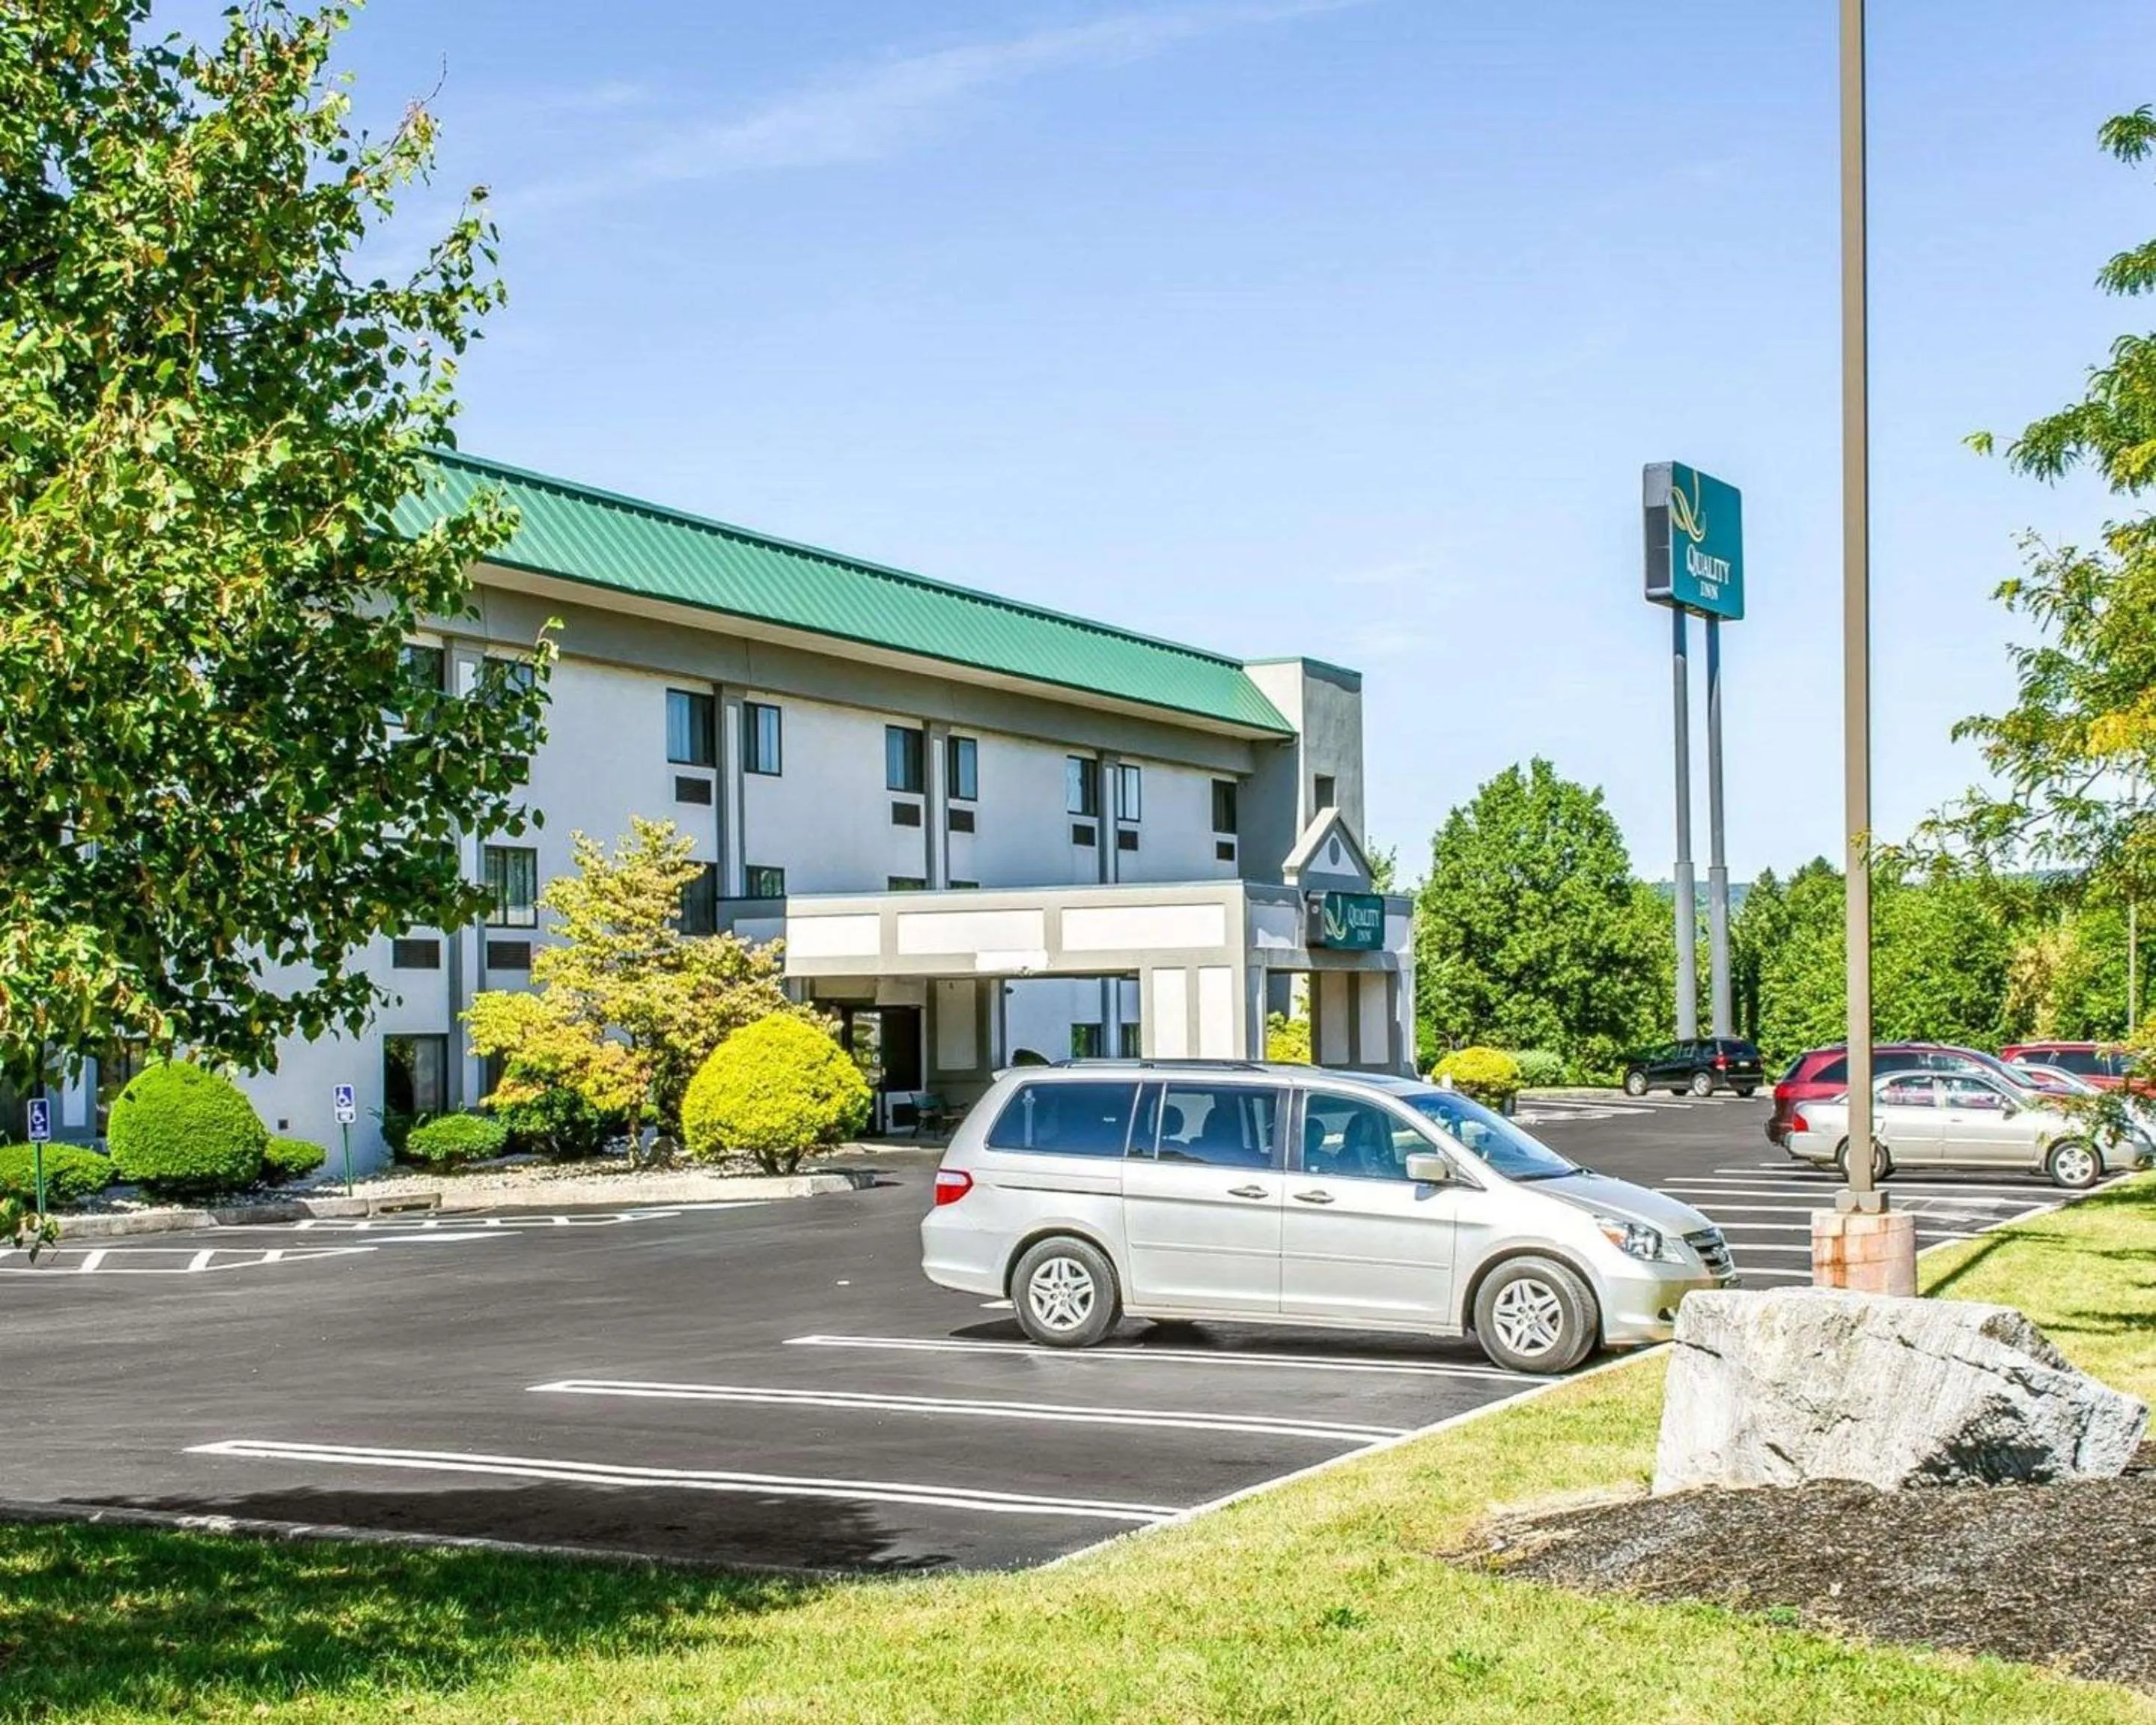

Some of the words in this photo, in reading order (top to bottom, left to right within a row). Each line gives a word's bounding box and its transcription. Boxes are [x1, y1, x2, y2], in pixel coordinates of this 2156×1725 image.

[1687, 544, 1731, 585] QUALITY
[1700, 579, 1719, 600] INN
[1348, 903, 1380, 928] QUALITY
